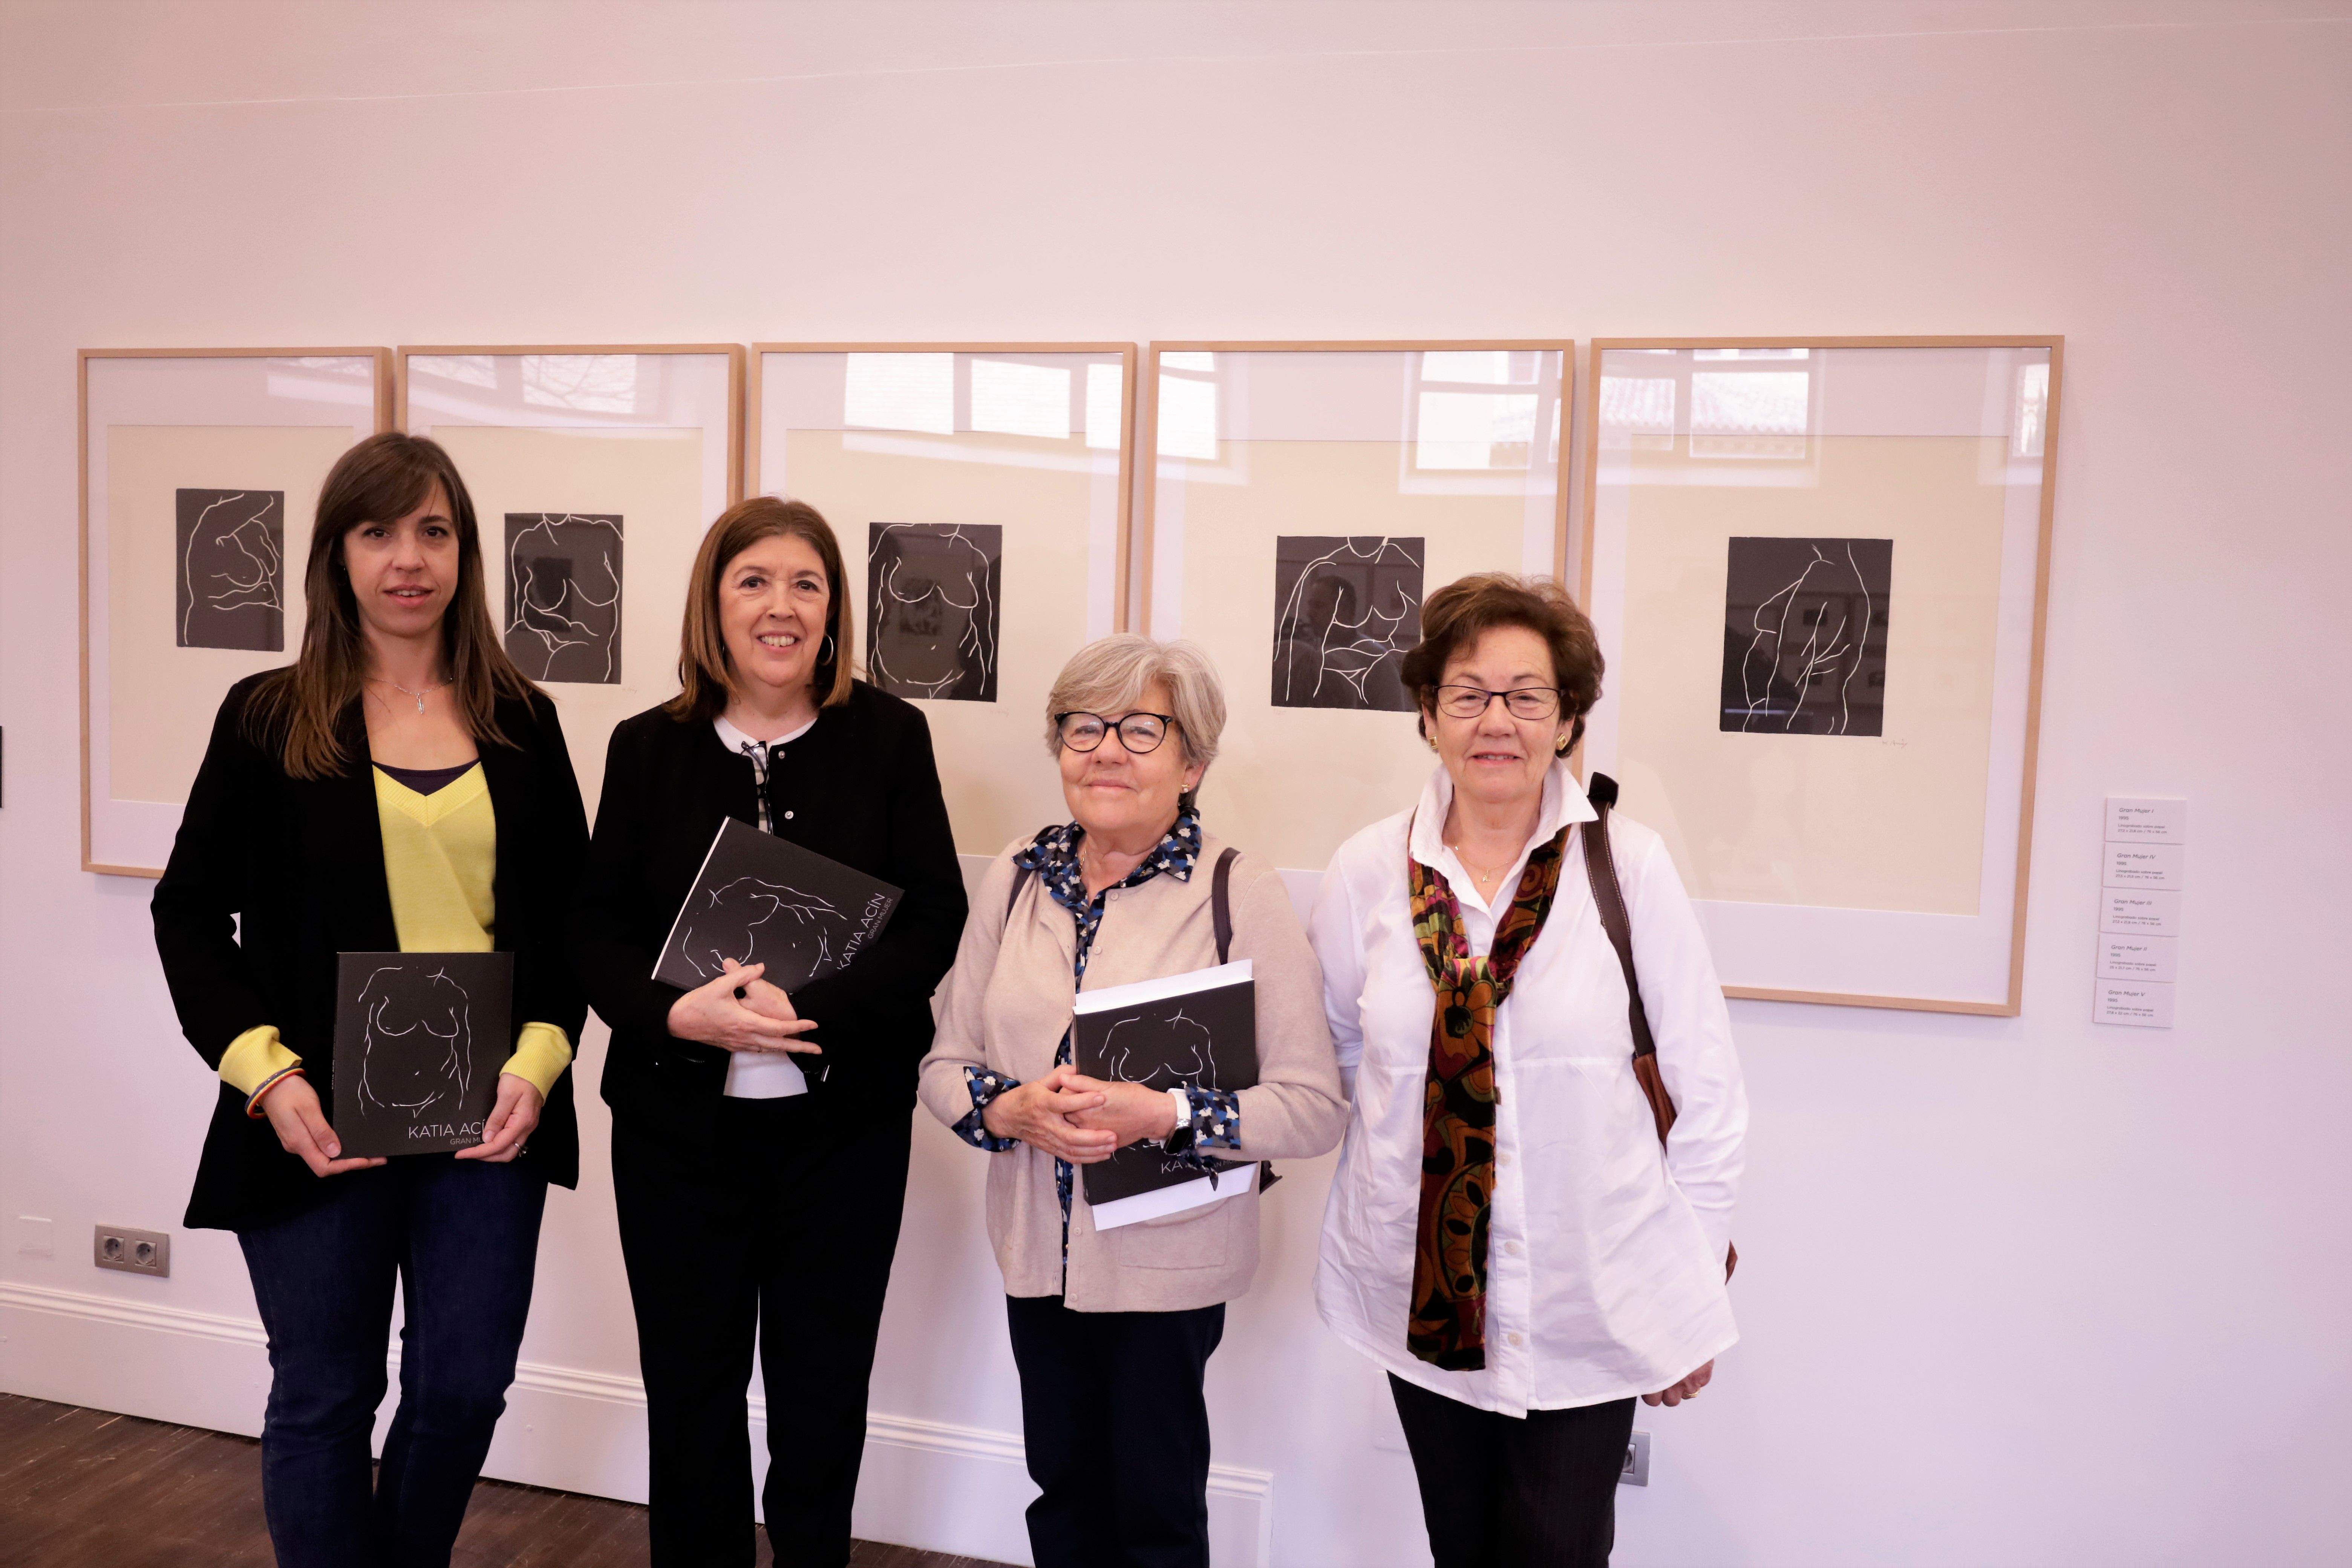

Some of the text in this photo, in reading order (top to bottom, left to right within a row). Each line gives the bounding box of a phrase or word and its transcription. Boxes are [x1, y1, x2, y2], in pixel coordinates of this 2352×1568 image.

[837, 893, 885, 970] KATIA ACÍN
[868, 897, 893, 939] GRAN MUJER
[409, 1119, 485, 1139] KATIA ACÍ
